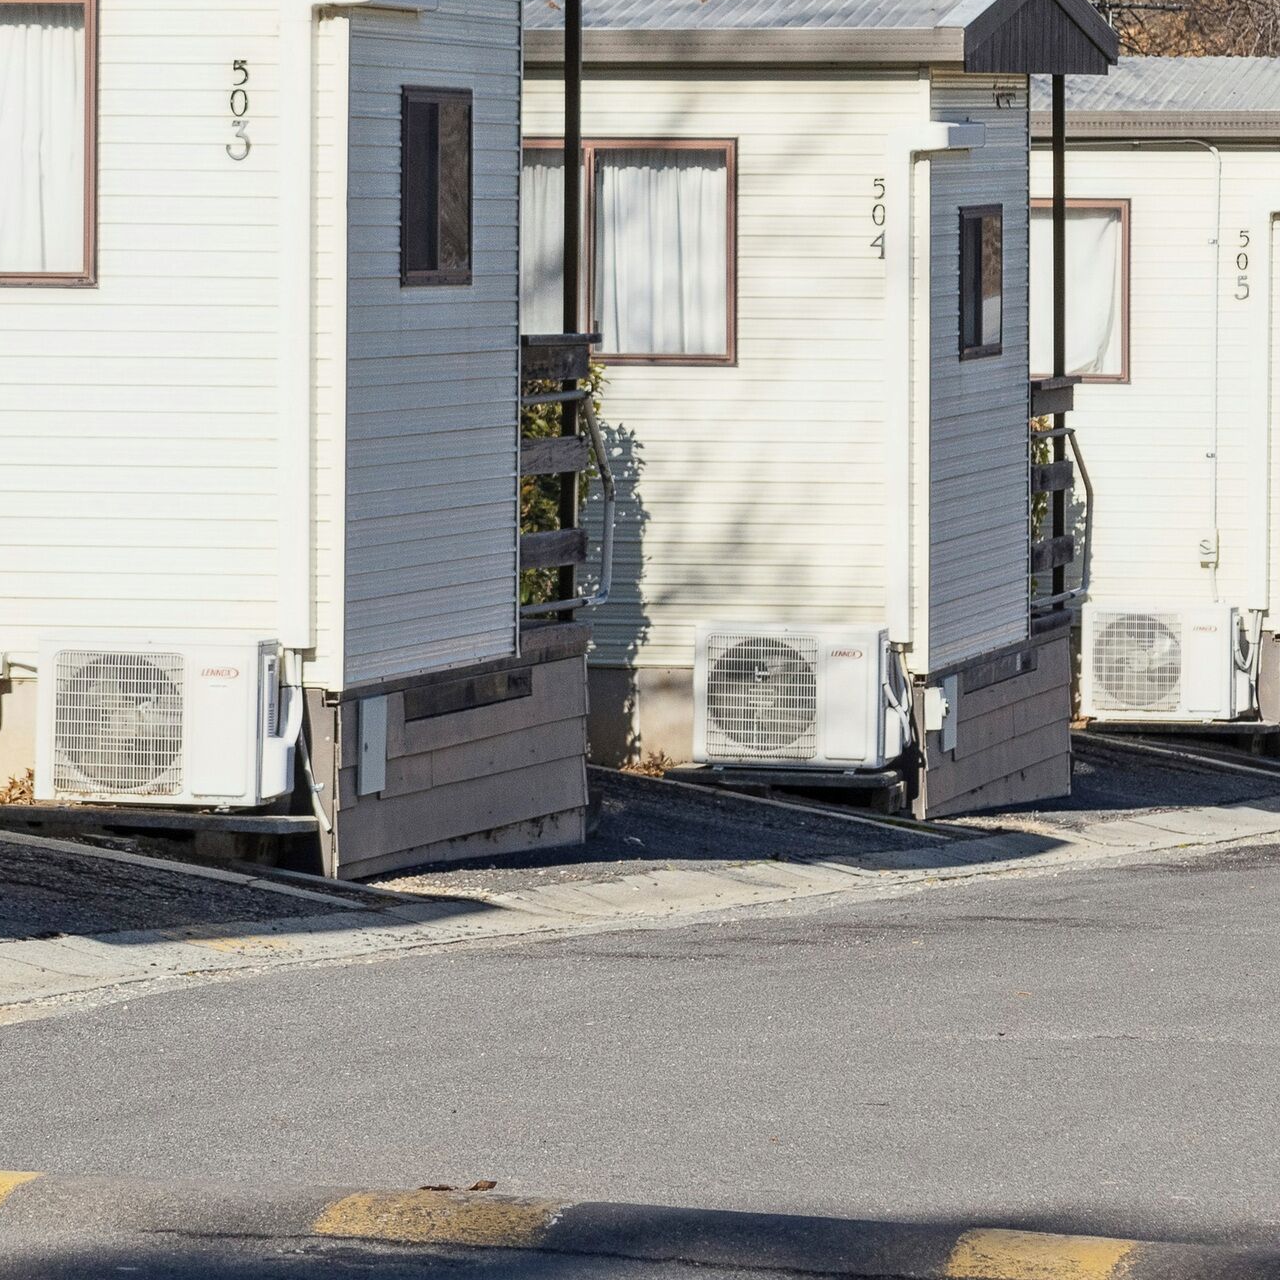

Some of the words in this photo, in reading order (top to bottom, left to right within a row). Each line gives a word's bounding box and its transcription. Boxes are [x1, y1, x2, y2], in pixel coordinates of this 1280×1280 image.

[225, 59, 251, 161] 503
[869, 178, 886, 260] 504
[1234, 230, 1251, 301] 505
